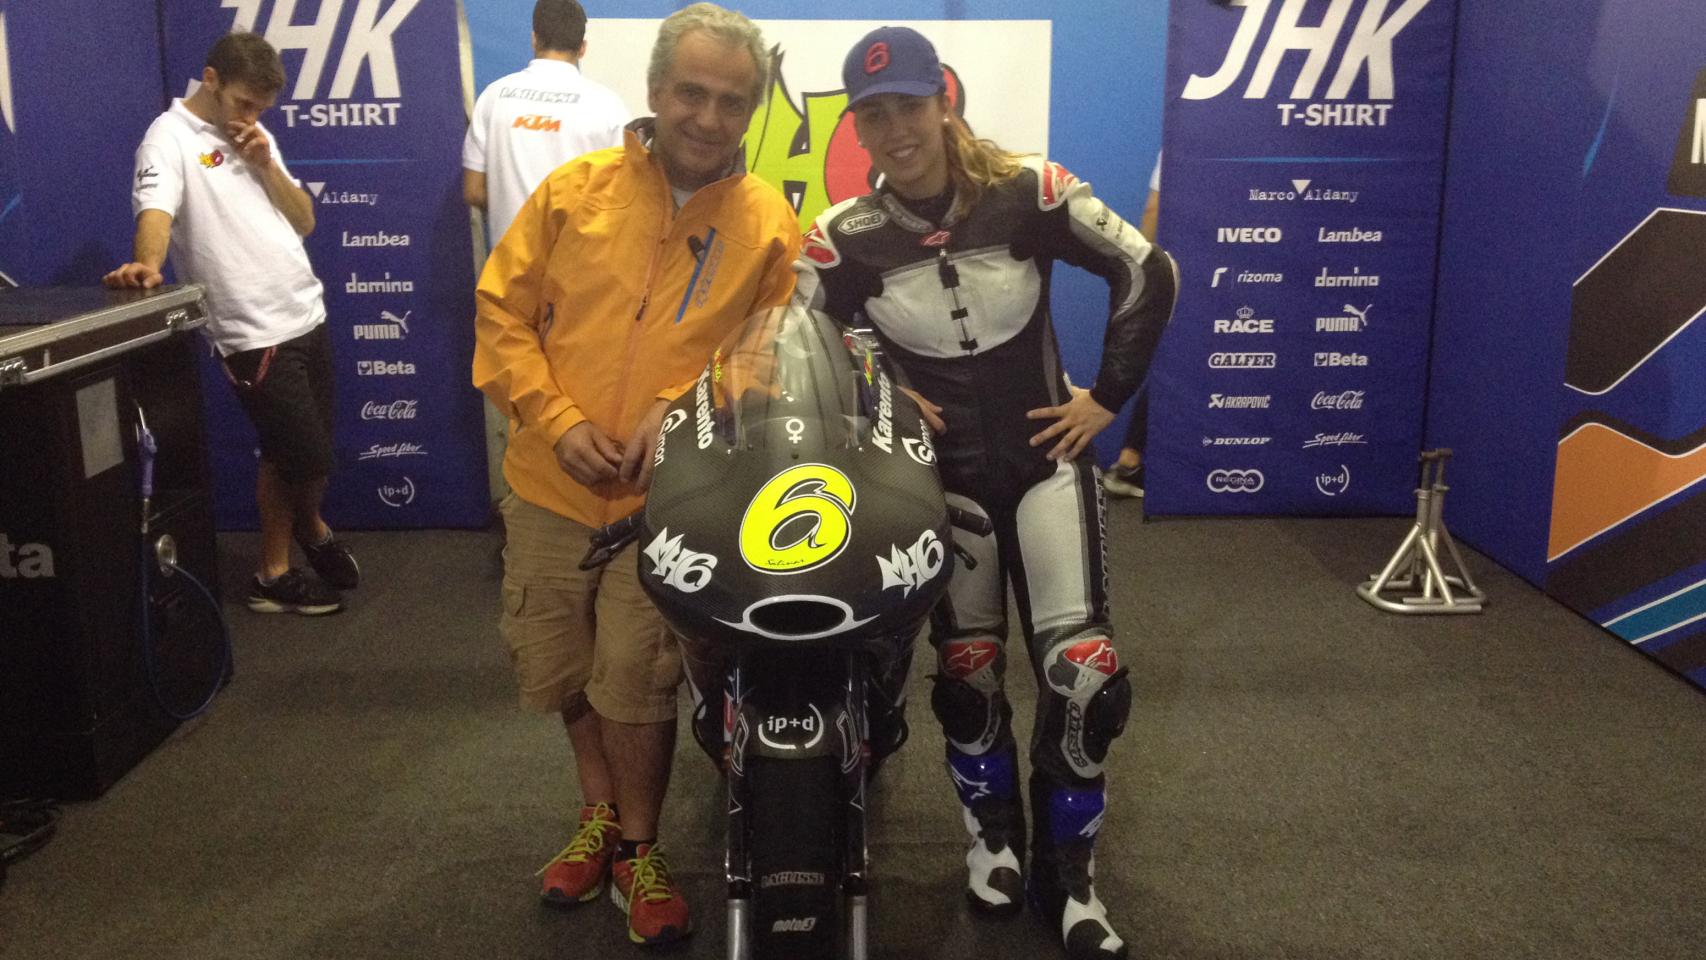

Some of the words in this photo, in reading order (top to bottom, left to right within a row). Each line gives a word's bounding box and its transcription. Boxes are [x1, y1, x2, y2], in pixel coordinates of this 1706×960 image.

[1181, 0, 1431, 100] JHK
[864, 41, 890, 75] 6
[280, 103, 402, 127] T-SHIRT
[1277, 103, 1393, 126] T-SHIRT
[511, 114, 562, 132] KTM
[321, 191, 379, 205] Aldany
[1304, 188, 1360, 203] Aldany
[342, 230, 410, 247] Lambea
[1217, 227, 1282, 243] IVECO
[1318, 227, 1382, 242] Lambea
[345, 271, 414, 293] domino
[1237, 270, 1283, 283] rizoma
[1315, 266, 1380, 287] domino
[353, 324, 401, 340] PUMA
[1213, 319, 1274, 333] RACE
[1316, 317, 1360, 332] PUMA
[1210, 354, 1275, 367] GALFER
[1328, 352, 1368, 367] Beta
[373, 360, 416, 375] Beta
[1213, 437, 1272, 446] DUNLOP
[1321, 473, 1344, 486] ip+d
[383, 484, 409, 497] ip+d
[739, 463, 857, 576] 6
[767, 715, 815, 734] ip+d
